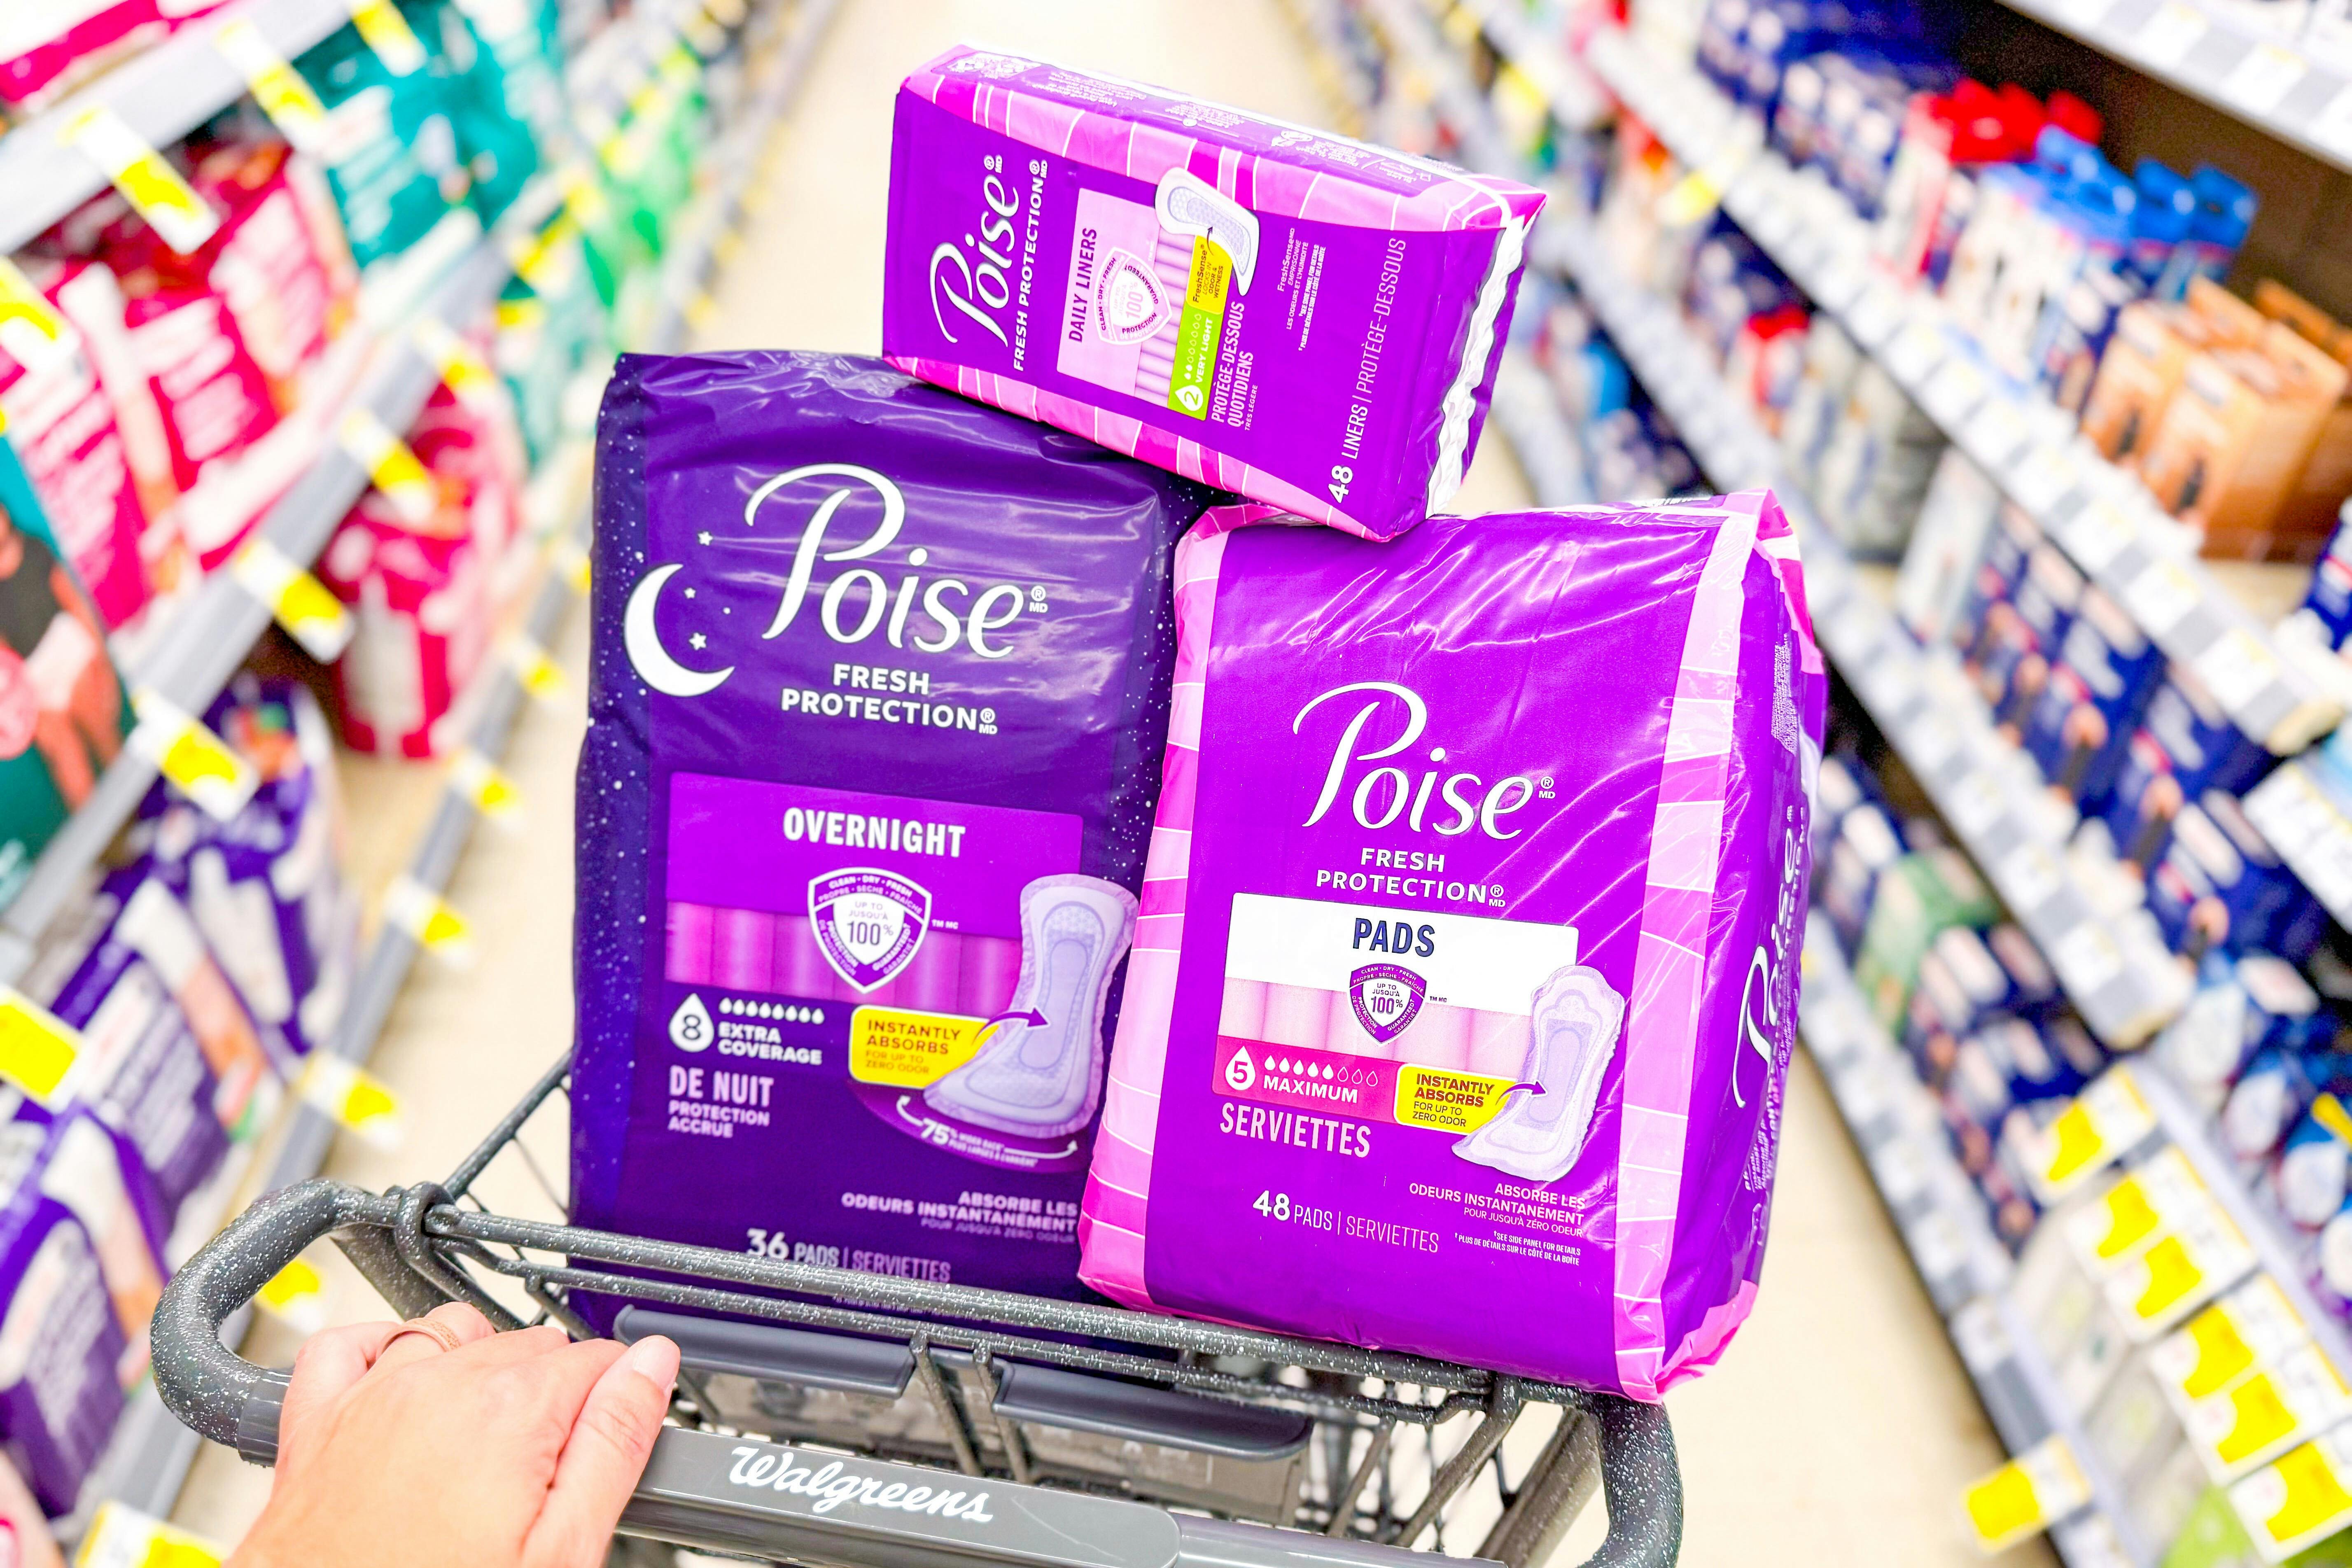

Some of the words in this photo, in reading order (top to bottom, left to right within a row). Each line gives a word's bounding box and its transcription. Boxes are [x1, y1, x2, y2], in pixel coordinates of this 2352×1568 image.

[1018, 177, 1043, 307] PROTECTION
[929, 174, 1020, 347] Poise
[1076, 228, 1097, 290] LINERS
[1103, 257, 1117, 282] FRESH
[1206, 262, 1212, 271] IN
[1209, 273, 1217, 294] ODOR
[1213, 266, 1223, 299] WETNESS
[1289, 287, 1299, 317] ODEURS
[1294, 280, 1300, 289] ET
[1069, 293, 1088, 343] DAILY
[1122, 312, 1157, 334] PROTECTION
[1013, 310, 1028, 371] FRESH
[1195, 354, 1206, 383] VERY
[1201, 317, 1213, 352] LIGHT
[1328, 464, 1353, 504] 48
[1341, 403, 1368, 460] LINERS
[1356, 238, 1407, 394] PROTÈGE-DESSOUS
[1184, 391, 1199, 406] 2
[1227, 351, 1253, 427] QUOTIDIENS
[744, 462, 1024, 658] Poise
[832, 663, 931, 695] FRESH
[780, 688, 978, 731] PROTECTION
[1293, 681, 1533, 840] Poise
[783, 807, 966, 858] OVERNIGHT
[1360, 847, 1445, 873] FRESH
[818, 887, 850, 903] PROPRE
[828, 876, 856, 889] CLEAN
[862, 875, 881, 884] DRY
[886, 880, 913, 897] FRESH
[1316, 869, 1486, 903] PROTECTION
[826, 920, 859, 968] PROTECTION
[1353, 917, 1435, 957] PADS
[1353, 973, 1374, 984] PROPRE
[1399, 969, 1416, 981] FRESH
[1354, 1004, 1376, 1035] PROTECTION
[1358, 996, 1378, 1029] PROTECTION
[682, 1014, 701, 1041] 8
[718, 1021, 782, 1043] EXTRA
[868, 1020, 961, 1041] INSTANTLY
[718, 1038, 822, 1066] COVERAGE
[866, 1050, 887, 1059] FOR
[891, 1052, 905, 1061] UP
[910, 1055, 924, 1064] TO
[867, 1035, 949, 1055] ABSORBS
[866, 1060, 894, 1071] ZERO
[898, 1064, 929, 1075] ODOR
[1232, 1060, 1248, 1084] 5
[669, 1064, 704, 1099] DE
[713, 1070, 775, 1108] NUIT
[1263, 1075, 1358, 1104] MAXIMUM
[1414, 1087, 1484, 1108] ABSORBS
[1416, 1073, 1495, 1095] INSTANTLY
[668, 1099, 770, 1127] PROTECTION
[1412, 1111, 1437, 1122] ZERO
[1439, 1115, 1467, 1127] ODOR
[1414, 1101, 1432, 1112] FOR
[1435, 1104, 1448, 1113] UP
[1450, 1106, 1462, 1116] TO
[667, 1115, 733, 1139] ACCRUE
[1220, 1102, 1371, 1158] SERVIETTES
[841, 1192, 914, 1215] ODEURS
[958, 1190, 1042, 1213] ABSORBE
[1046, 1200, 1077, 1217] LES
[1409, 1182, 1461, 1202] ODEURS
[1464, 1192, 1584, 1225] INSTANTANÉMENT
[1494, 1183, 1558, 1205] ABSORBE
[1561, 1195, 1586, 1210] LES
[1252, 1190, 1291, 1222] 48
[1294, 1204, 1333, 1231] PADS
[1346, 1215, 1440, 1253] SERVIETTES
[1463, 1206, 1486, 1219] POUR
[1488, 1213, 1524, 1227] JUSQU'À
[1526, 1218, 1549, 1232] ZÉRO
[1551, 1223, 1583, 1238] ODEUR
[746, 1227, 789, 1259] 36
[794, 1242, 840, 1267] PADS
[852, 1249, 952, 1283] SERVIETTES
[1458, 1234, 1473, 1244] PLUS
[1474, 1237, 1481, 1246] DE
[1507, 1244, 1519, 1253] SUR
[1544, 1251, 1552, 1260] DE
[1553, 1253, 1561, 1262] LA
[1508, 1234, 1522, 1245] SIDE
[1523, 1238, 1542, 1249] PANEL
[1543, 1241, 1555, 1251] FOR
[1556, 1244, 1581, 1256] DETAILS
[729, 1446, 993, 1522] Walgreens
